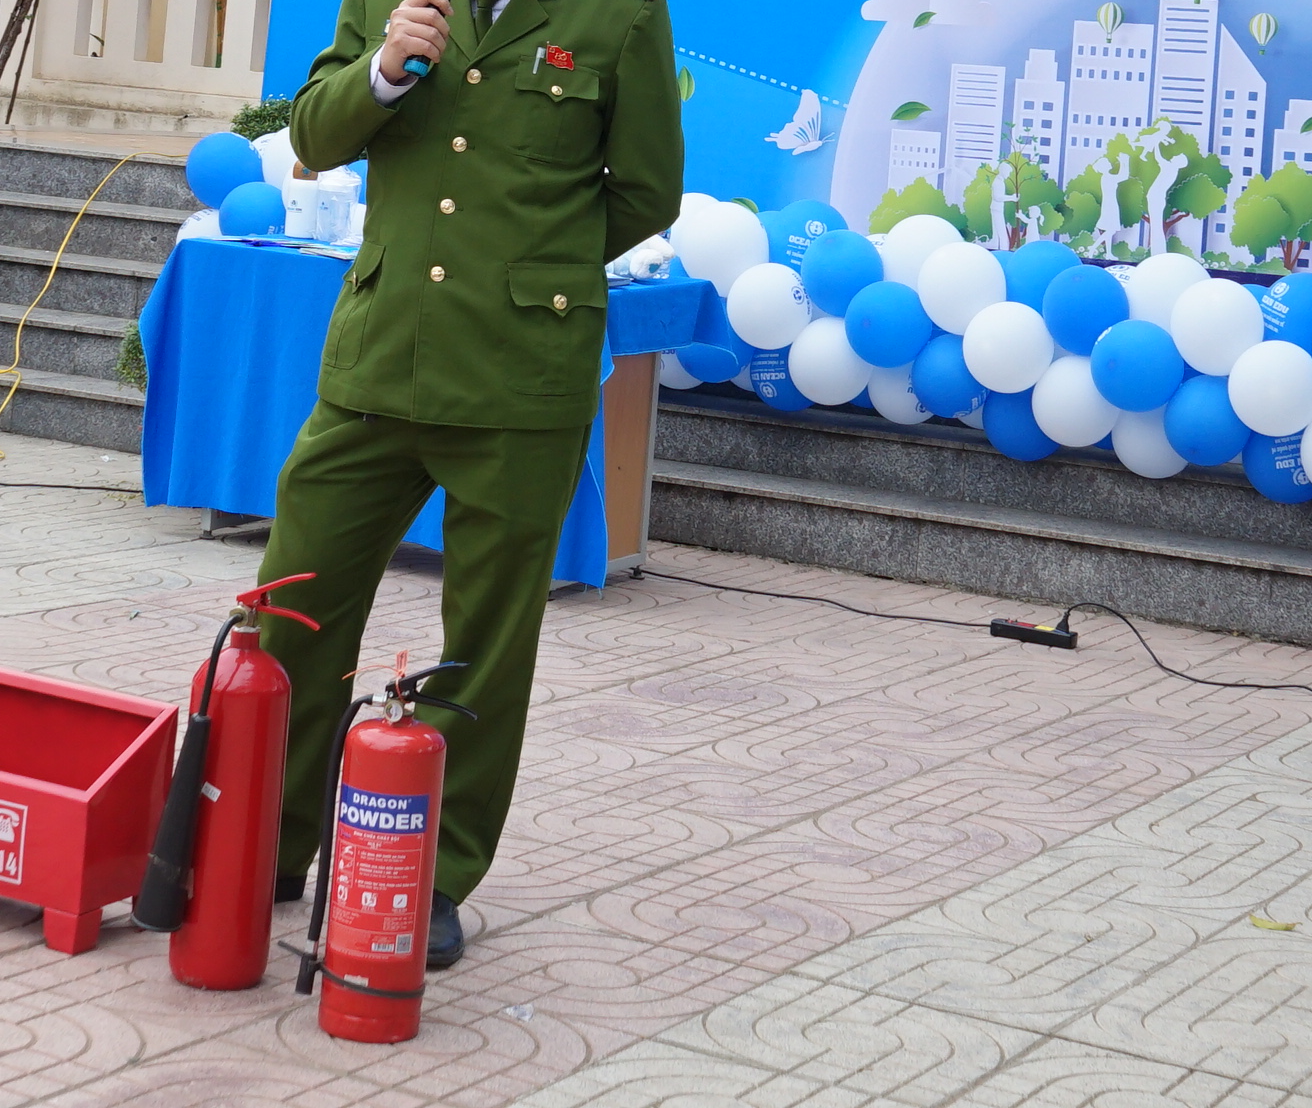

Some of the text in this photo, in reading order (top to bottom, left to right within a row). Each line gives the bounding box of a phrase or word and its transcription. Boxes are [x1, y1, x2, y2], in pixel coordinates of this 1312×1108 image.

[1275, 459, 1294, 468] EDU
[352, 792, 408, 810] DRAGON
[339, 802, 424, 830] POWDER
